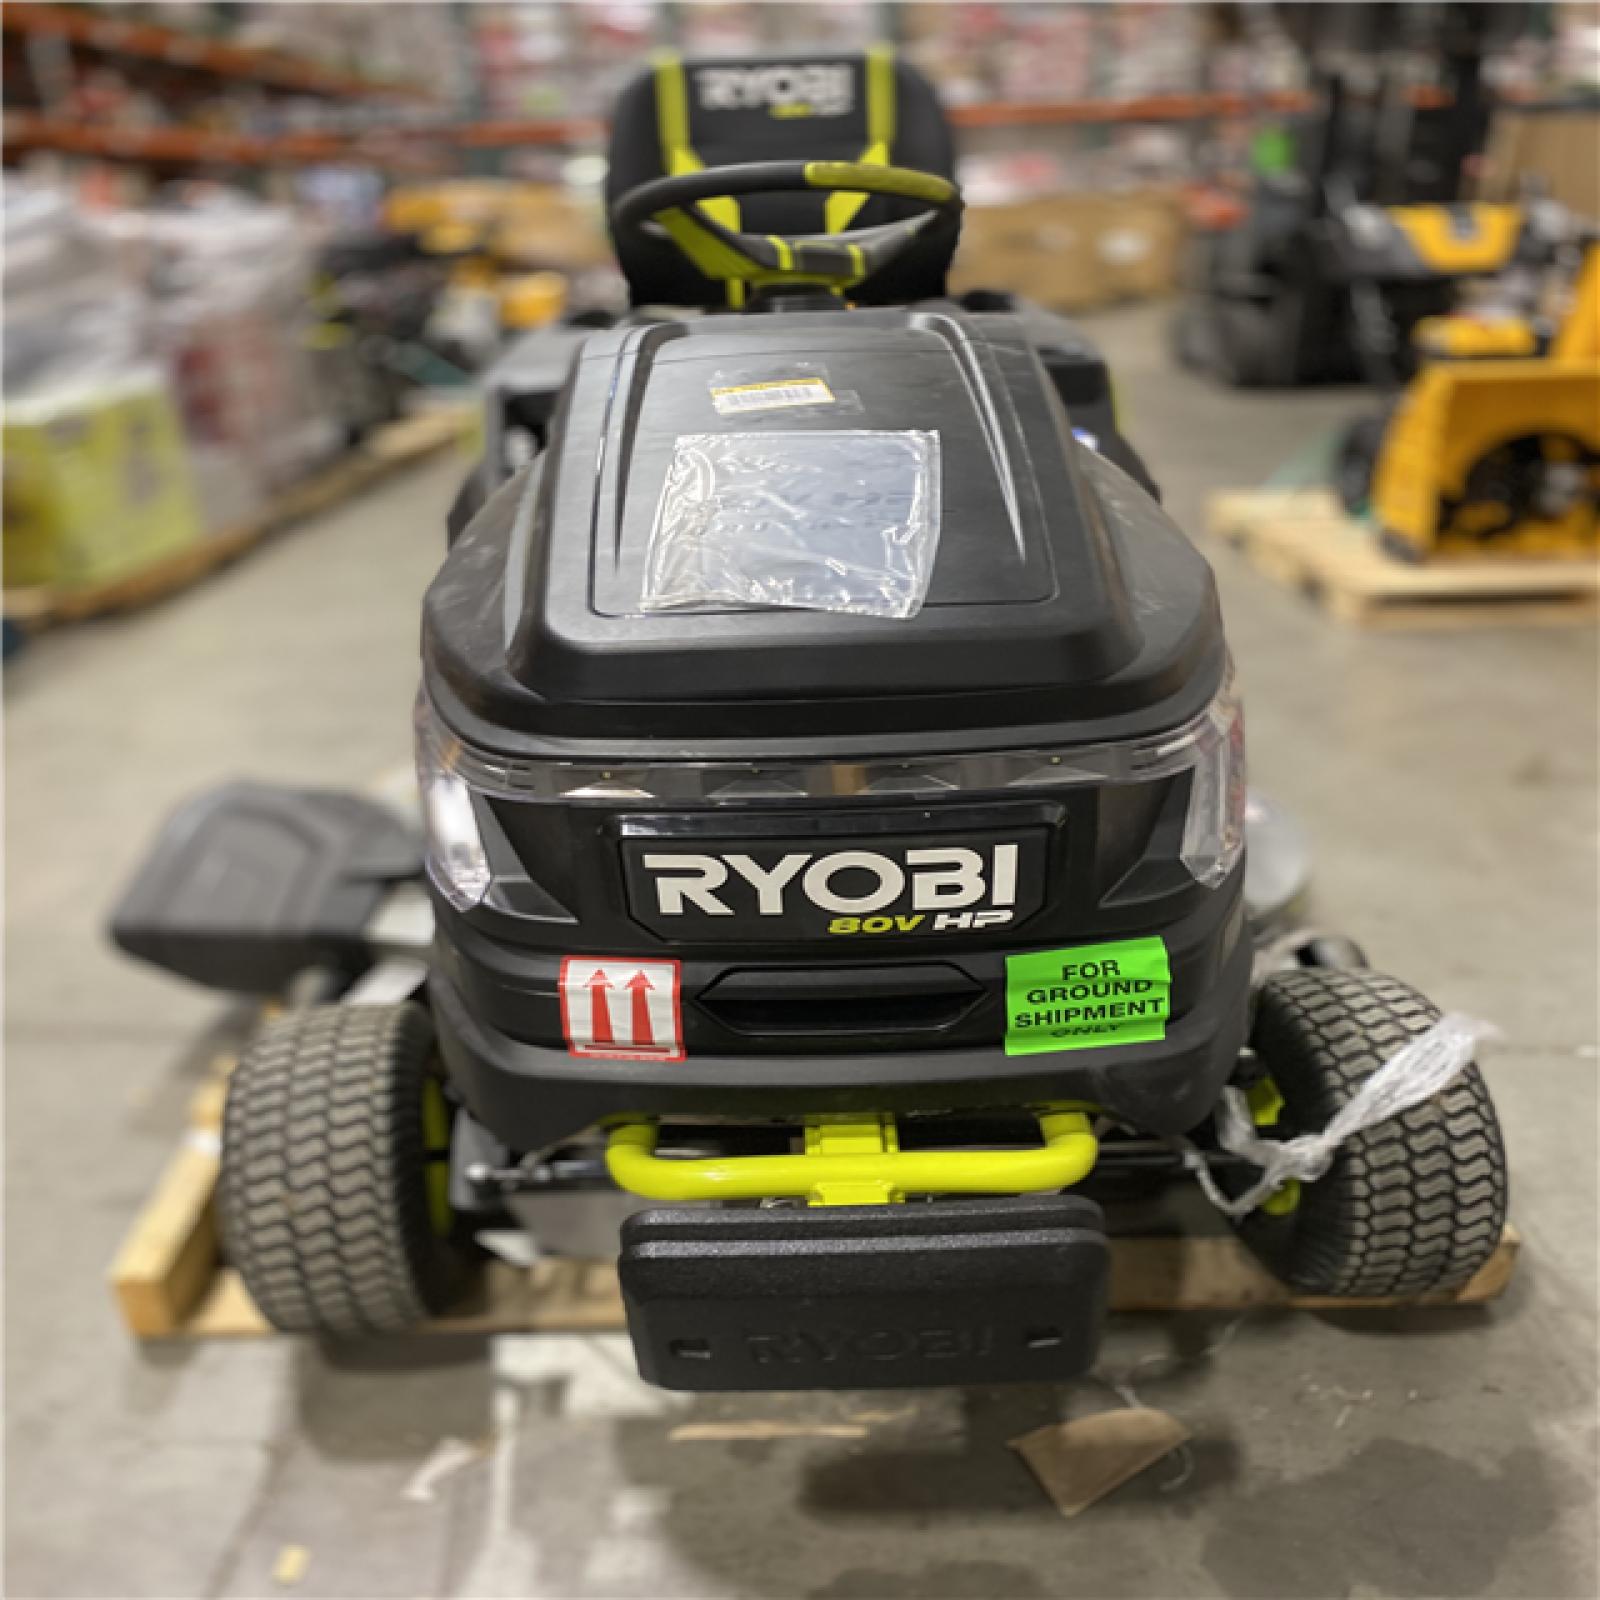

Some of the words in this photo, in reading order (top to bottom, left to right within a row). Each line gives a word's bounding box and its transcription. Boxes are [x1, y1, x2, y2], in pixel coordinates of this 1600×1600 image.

[694, 64, 855, 110] RYOBI
[643, 844, 1018, 915] RYOBI
[828, 915, 925, 934] 80V
[932, 910, 1013, 931] HP
[1062, 959, 1121, 981] FOR
[1027, 979, 1153, 1005] GROUND
[1015, 997, 1165, 1028] SHIPMENT
[745, 1326, 995, 1364] RYOBI
